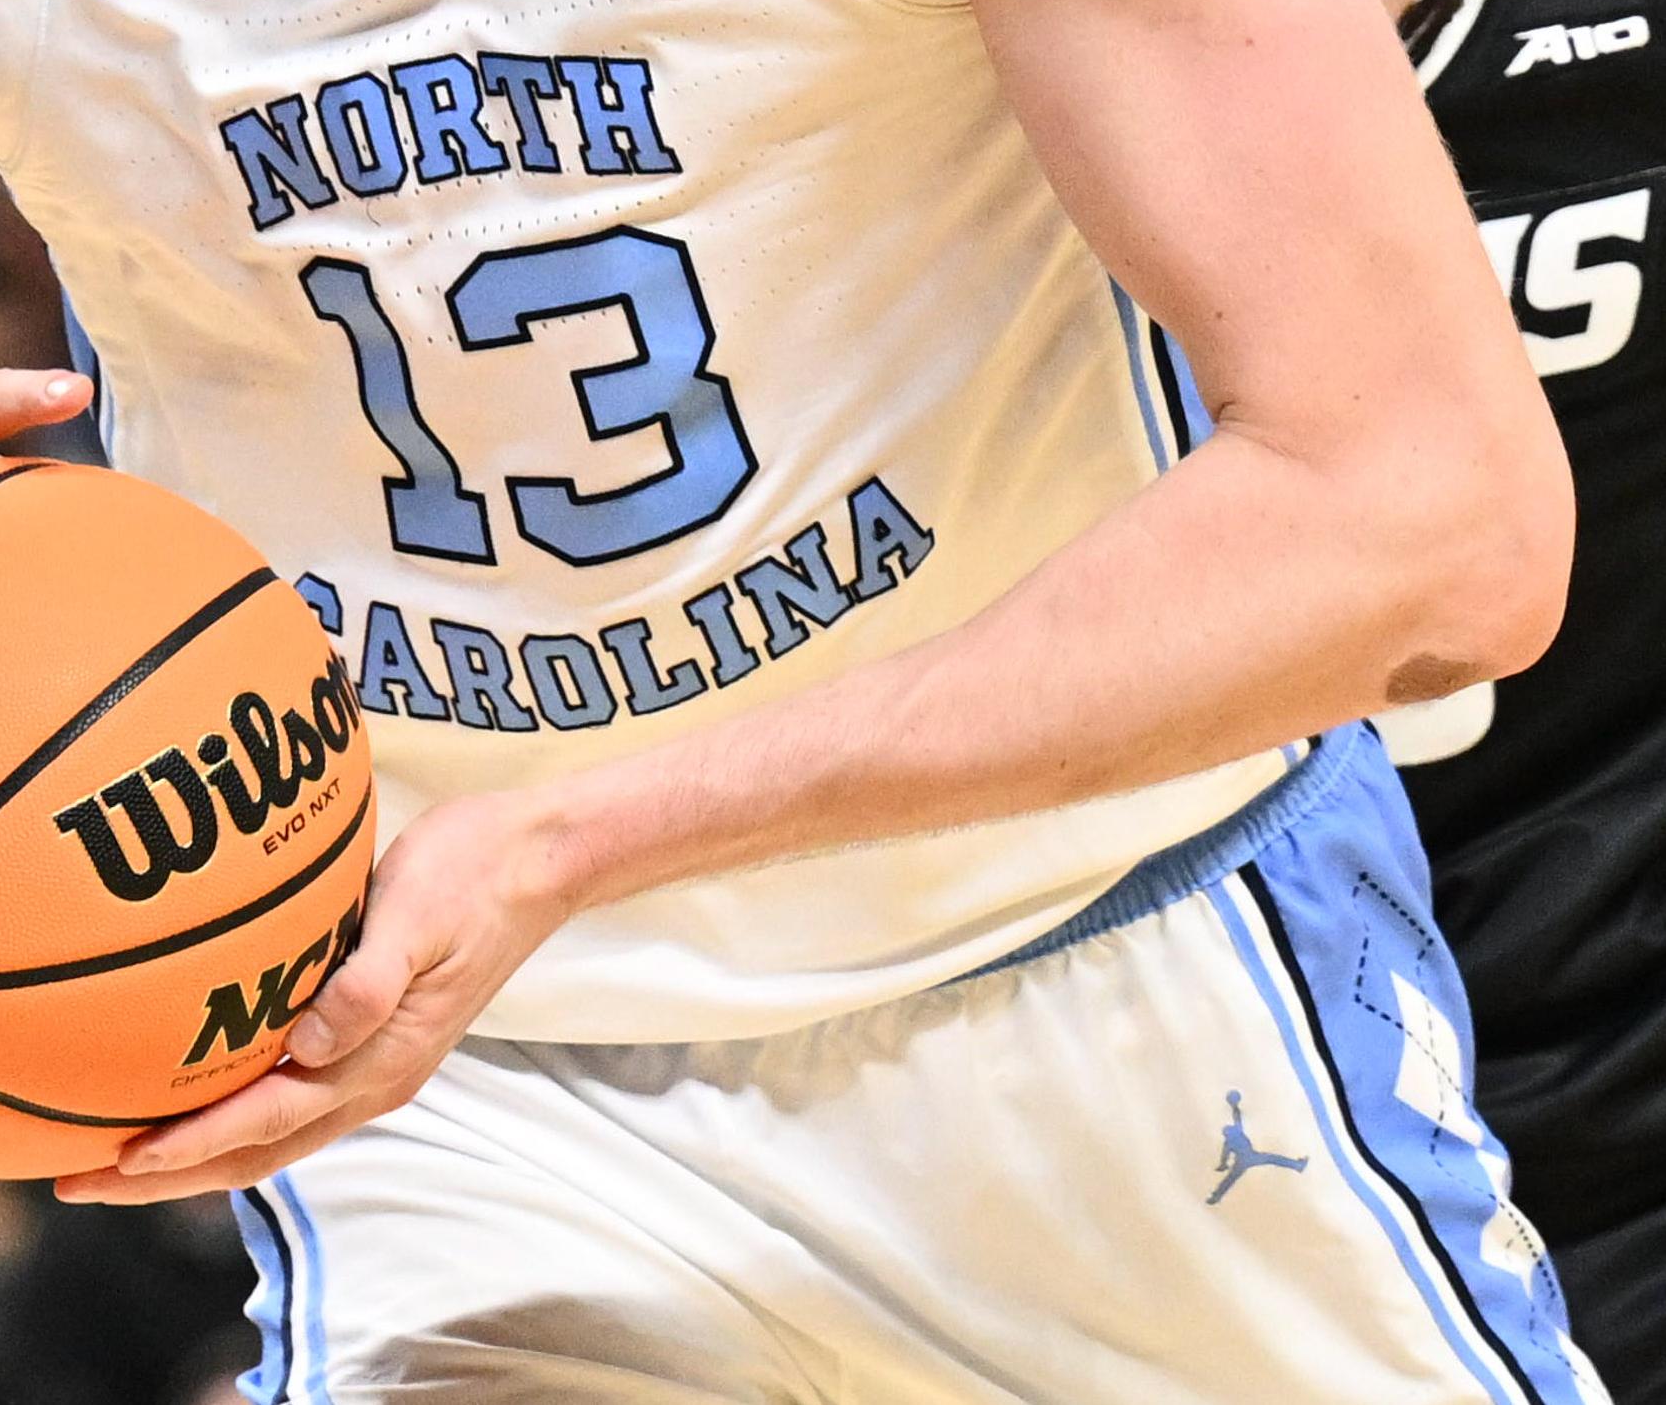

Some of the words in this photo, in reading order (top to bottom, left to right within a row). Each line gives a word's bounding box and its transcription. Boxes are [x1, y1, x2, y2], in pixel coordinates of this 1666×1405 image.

[1503, 15, 1650, 78] A10
[220, 51, 683, 231] NORTH
[298, 225, 759, 567] 13
[52, 647, 361, 902] Wilson
[262, 811, 306, 856] EVO
[309, 777, 341, 818] NXT
[181, 896, 364, 1067] NCA
